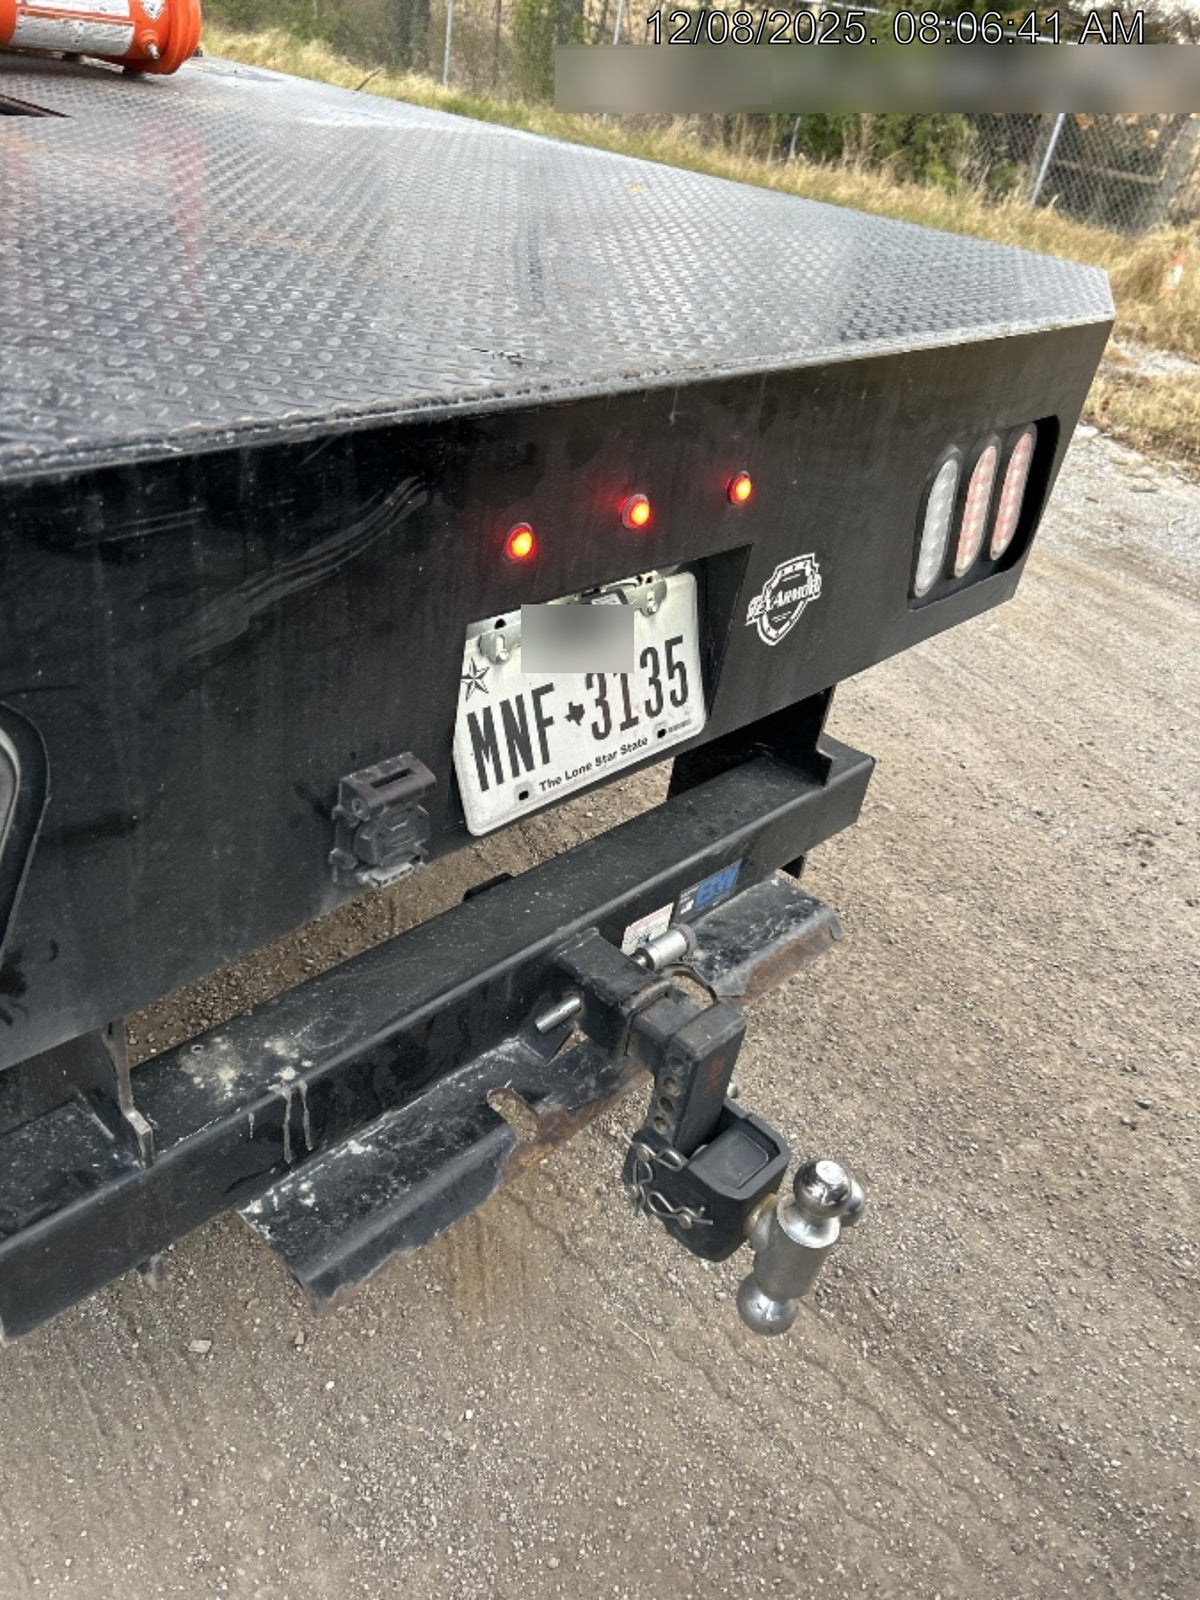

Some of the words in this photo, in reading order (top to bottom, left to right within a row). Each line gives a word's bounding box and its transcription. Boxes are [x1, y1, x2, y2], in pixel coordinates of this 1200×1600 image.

[467, 682, 554, 792] MNF
[585, 635, 689, 740] 3135
[539, 776, 562, 791] The
[565, 762, 592, 781] Lone
[594, 750, 617, 767] Star
[620, 737, 648, 755] State
